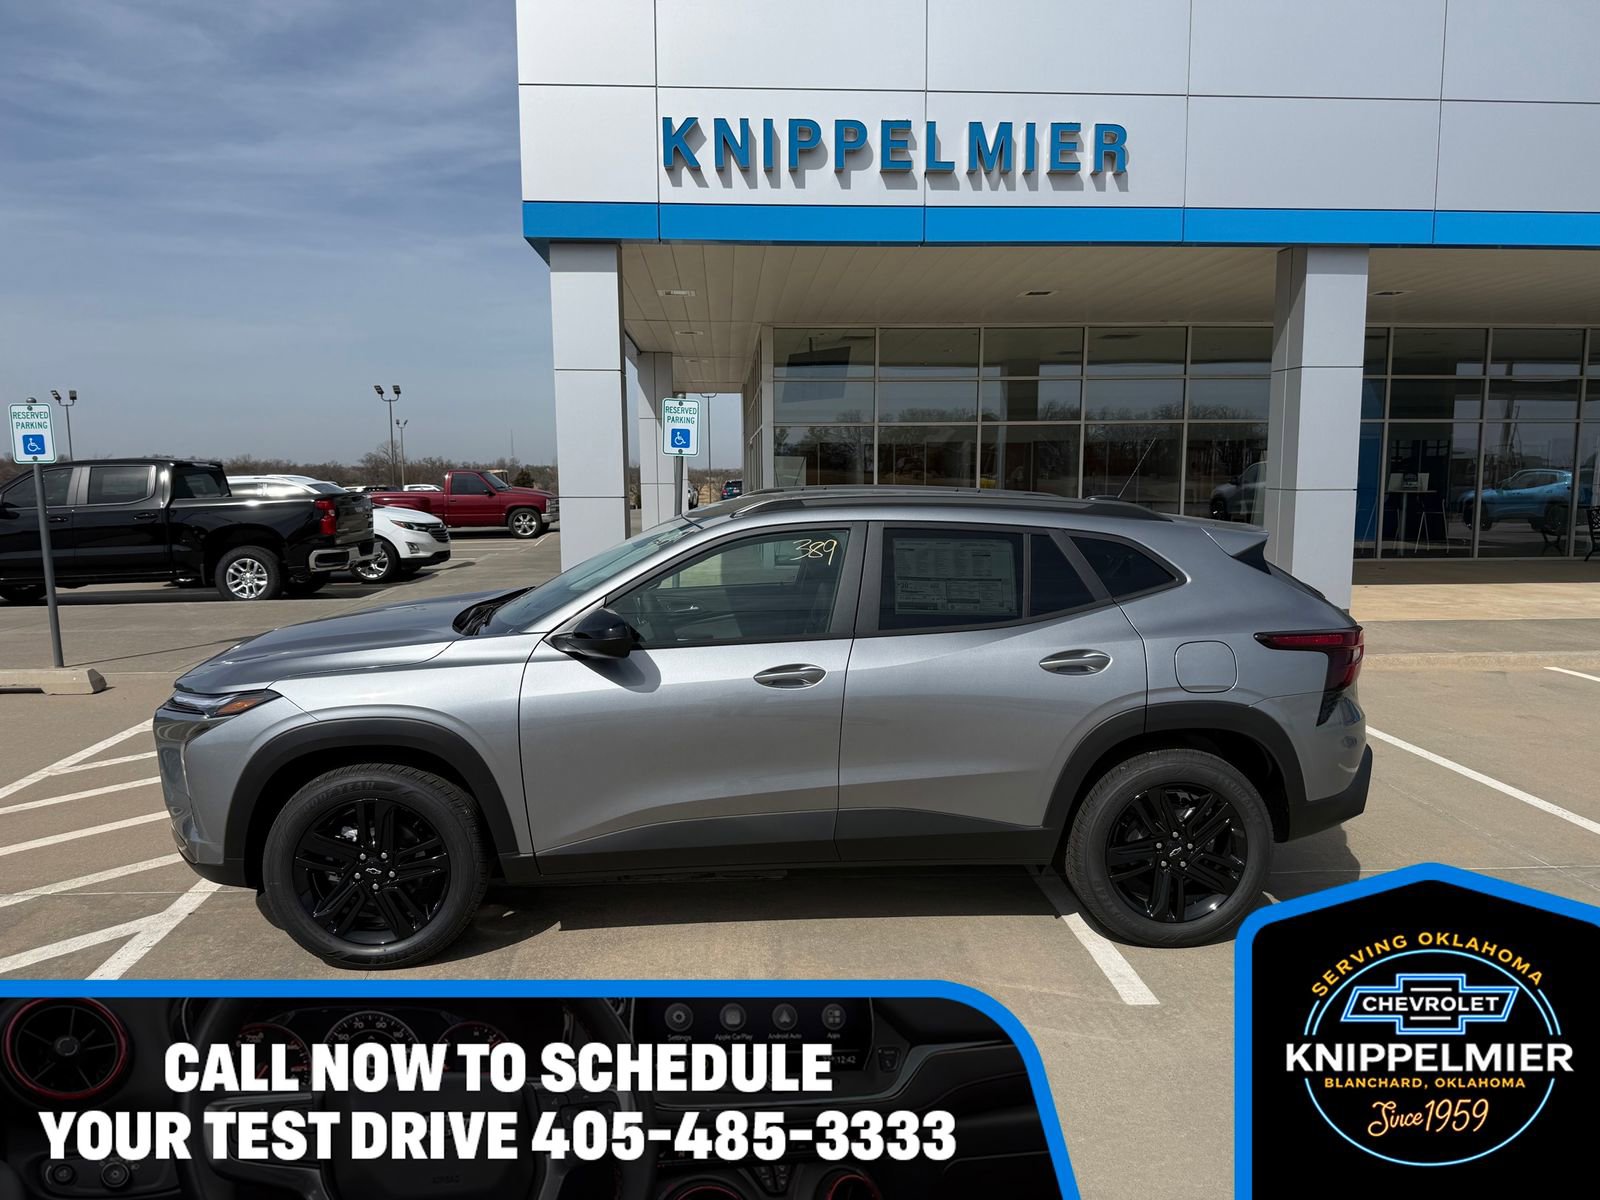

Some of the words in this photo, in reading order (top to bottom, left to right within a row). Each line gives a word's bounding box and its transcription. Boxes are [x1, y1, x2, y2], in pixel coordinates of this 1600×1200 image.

[662, 116, 1128, 175] KNIPPELMIER
[665, 406, 697, 415] RESERVED
[12, 411, 49, 420] RESERVED
[667, 416, 695, 425] PARKING
[15, 421, 48, 430] PARKING
[790, 539, 837, 566] 389
